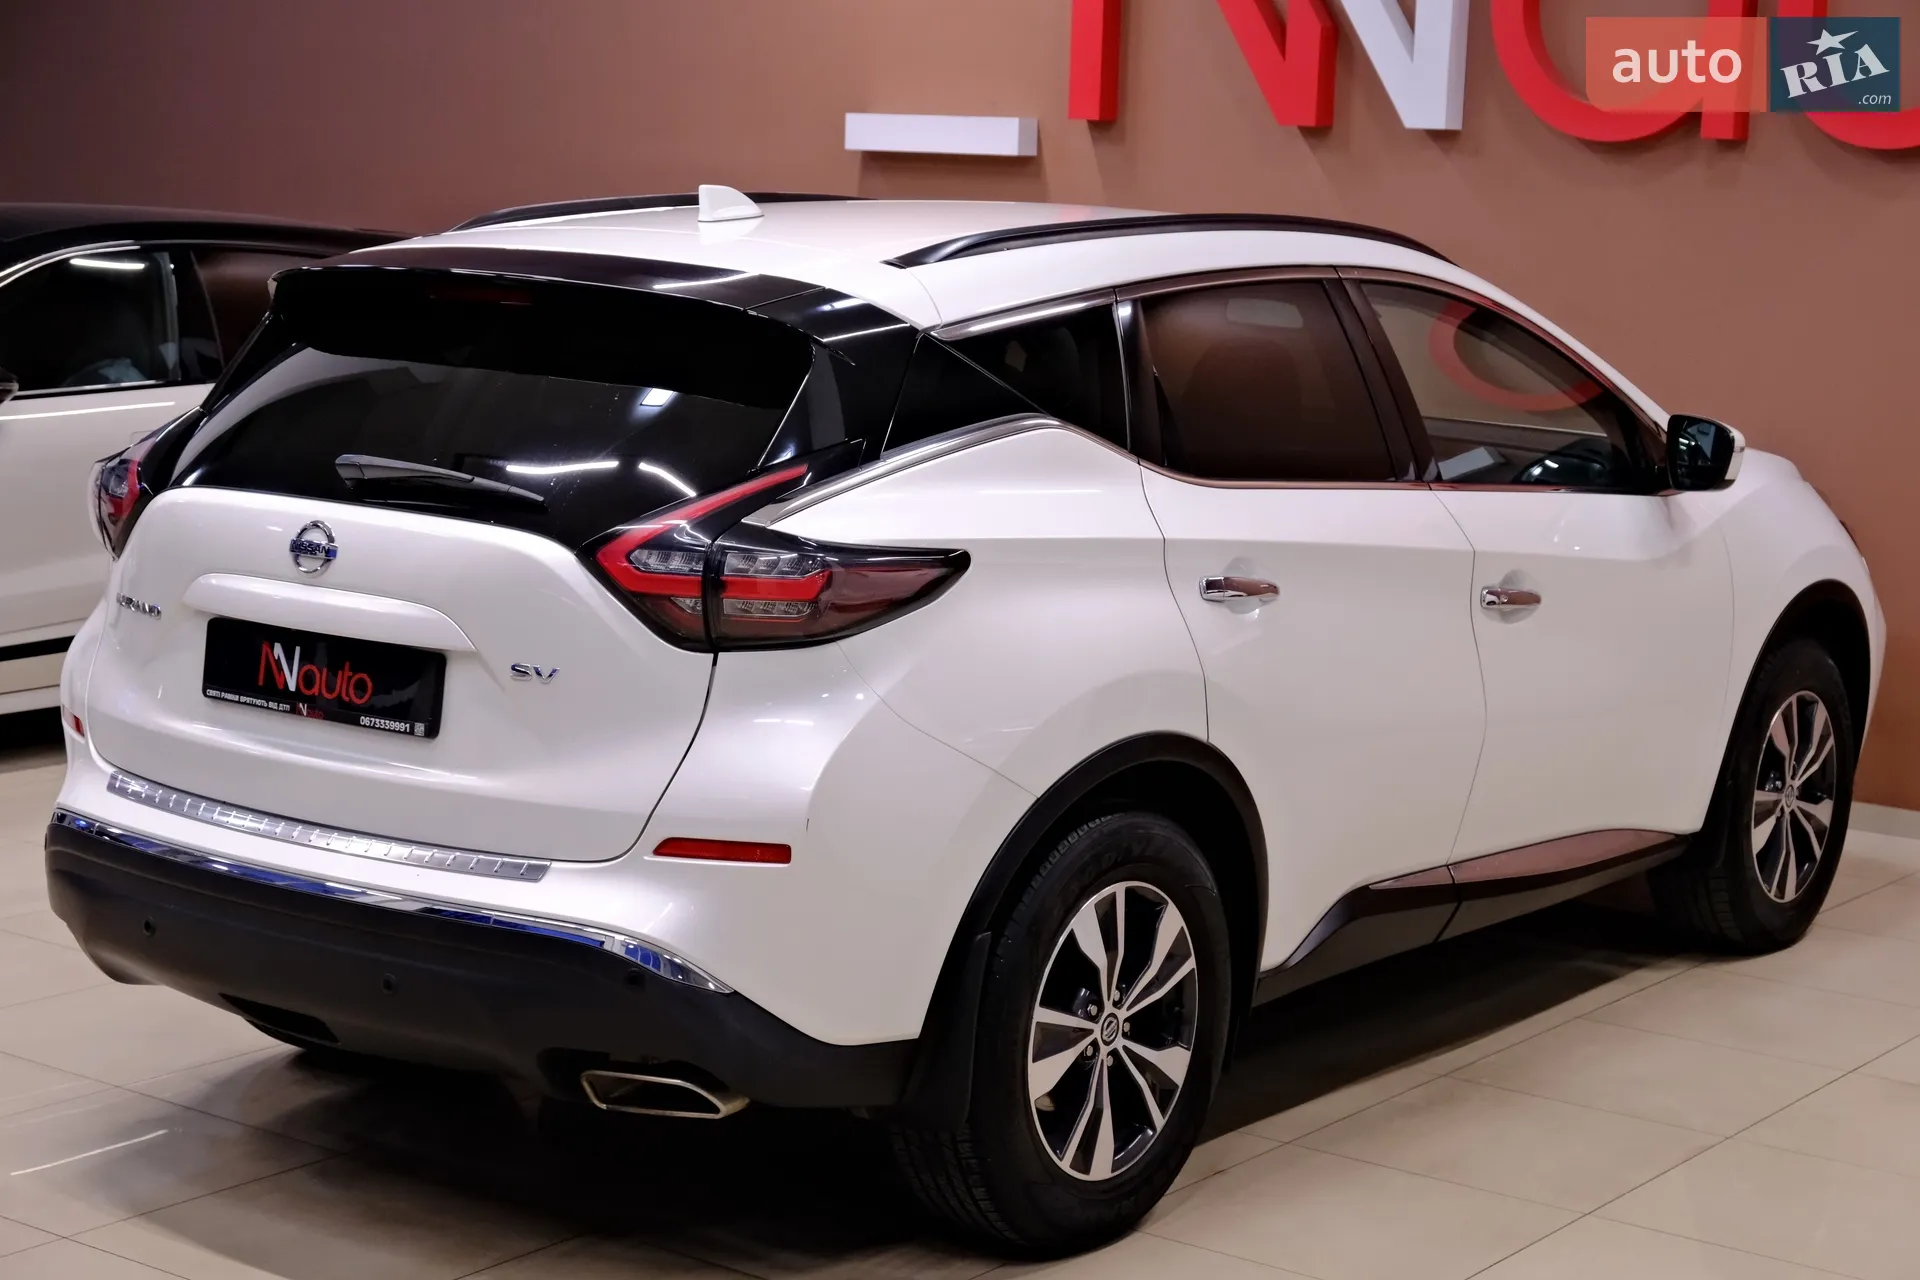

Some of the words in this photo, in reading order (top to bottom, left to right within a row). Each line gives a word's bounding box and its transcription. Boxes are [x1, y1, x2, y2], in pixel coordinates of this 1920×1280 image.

[291, 540, 330, 558] NISSAN
[510, 663, 560, 684] SV
[360, 716, 410, 733] 0673339991
